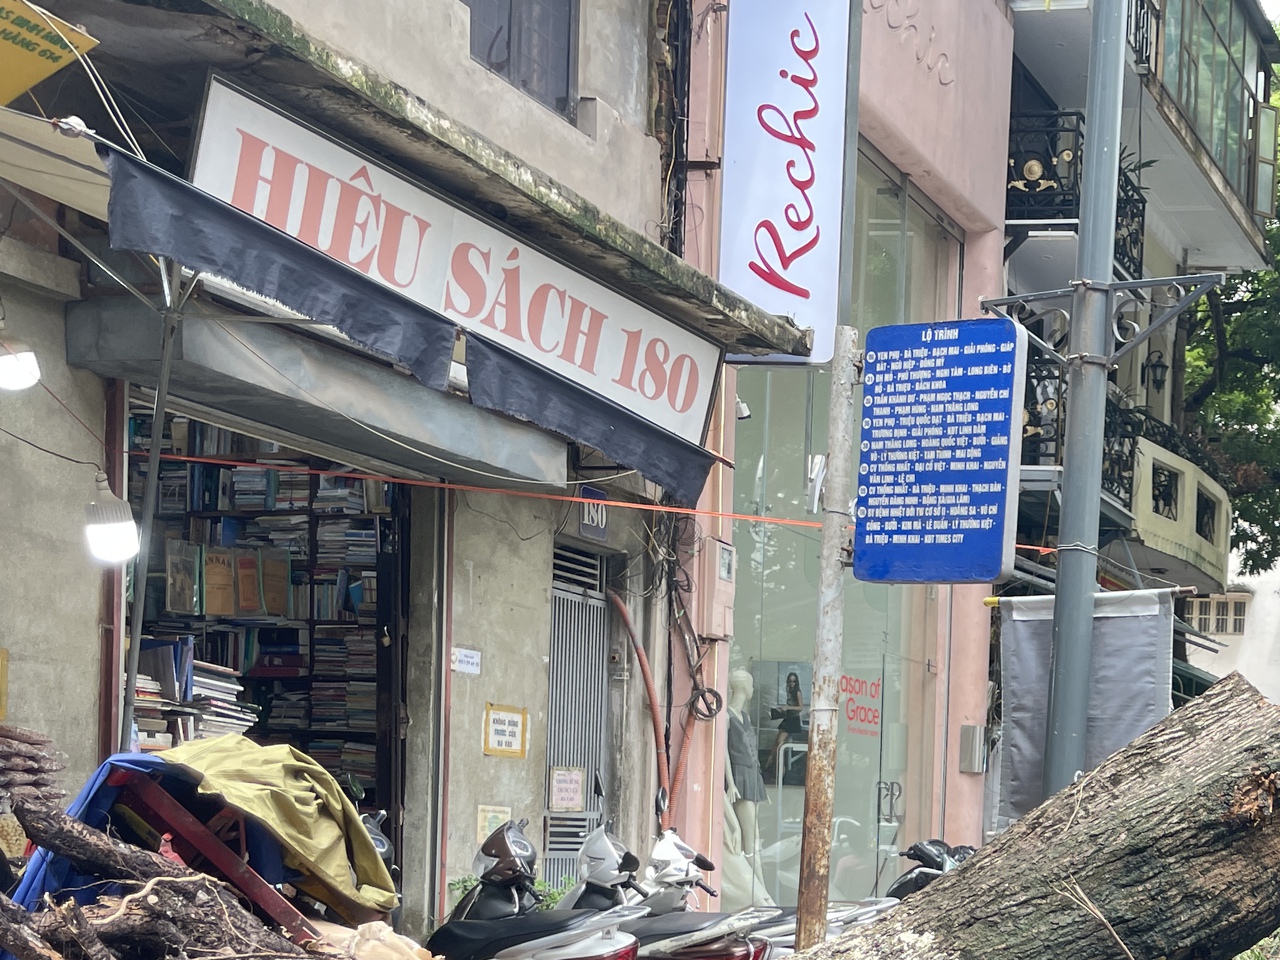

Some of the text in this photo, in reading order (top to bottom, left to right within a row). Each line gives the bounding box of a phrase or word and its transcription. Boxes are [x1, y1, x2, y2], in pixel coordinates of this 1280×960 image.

[748, 11, 822, 300] Rechic
[444, 246, 609, 376] SÁCH
[616, 327, 700, 415] 180
[922, 328, 959, 343] LỘ TRÌNH
[889, 350, 900, 360] PHỤ
[904, 349, 912, 358] BÀ
[932, 347, 947, 357] BẠCH
[949, 346, 959, 355] MAI
[977, 342, 996, 353] PHÓNG
[1001, 341, 1014, 352] GIÁP
[968, 366, 983, 375] LONG
[887, 384, 895, 392] BÀ
[932, 380, 947, 389] KHOA
[931, 404, 944, 413] NAM
[964, 402, 979, 411] LONG
[884, 418, 896, 427] PHỤ
[947, 414, 955, 423] BÀ
[977, 412, 992, 422] BẠCH
[993, 412, 1005, 421] MAI
[960, 425, 972, 434] LINH
[871, 441, 884, 449] NAM
[903, 440, 917, 448] LONG
[582, 502, 606, 528] 180
[840, 674, 881, 699] ason of
[846, 698, 880, 726] Grace
